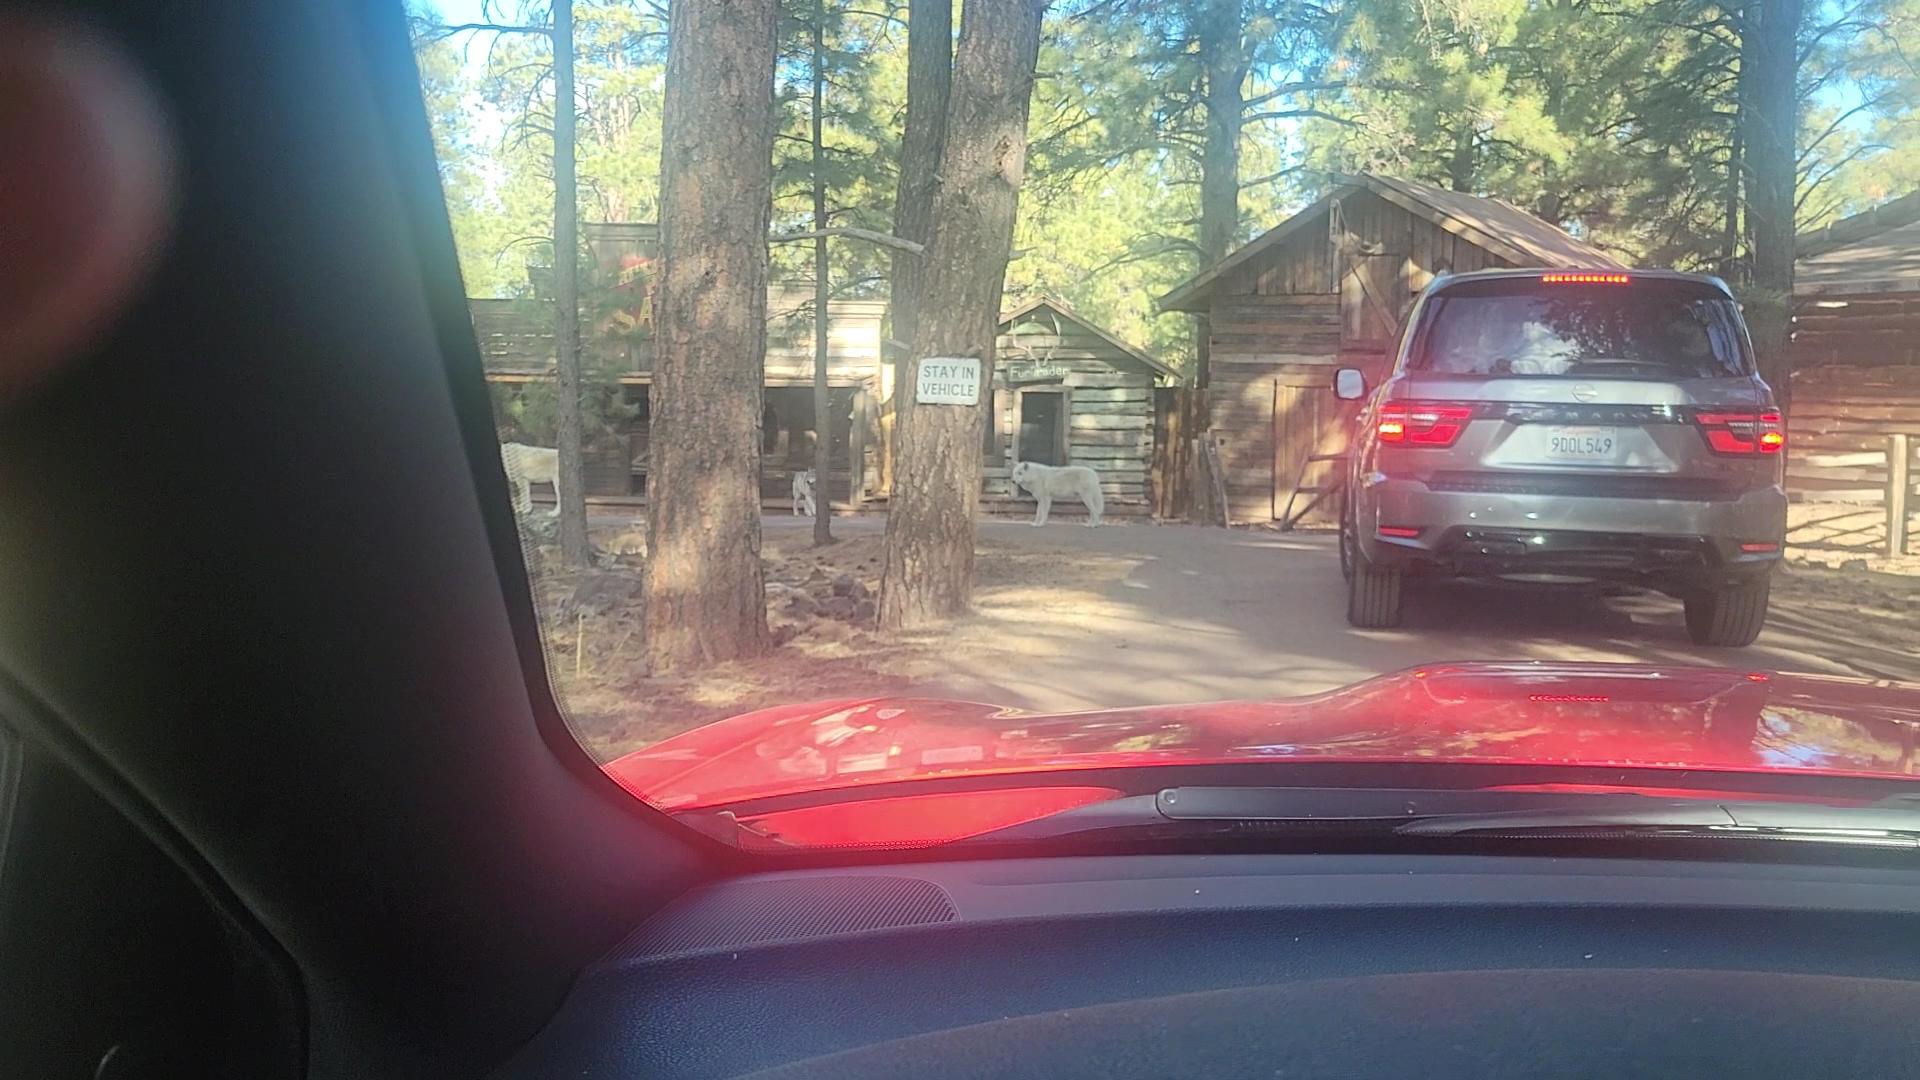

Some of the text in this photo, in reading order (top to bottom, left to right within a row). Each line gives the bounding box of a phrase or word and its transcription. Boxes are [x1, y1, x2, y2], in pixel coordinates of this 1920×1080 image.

[923, 366, 975, 379] STAY IN
[1010, 366, 1030, 378] Fur
[922, 383, 974, 397] VEHICLE
